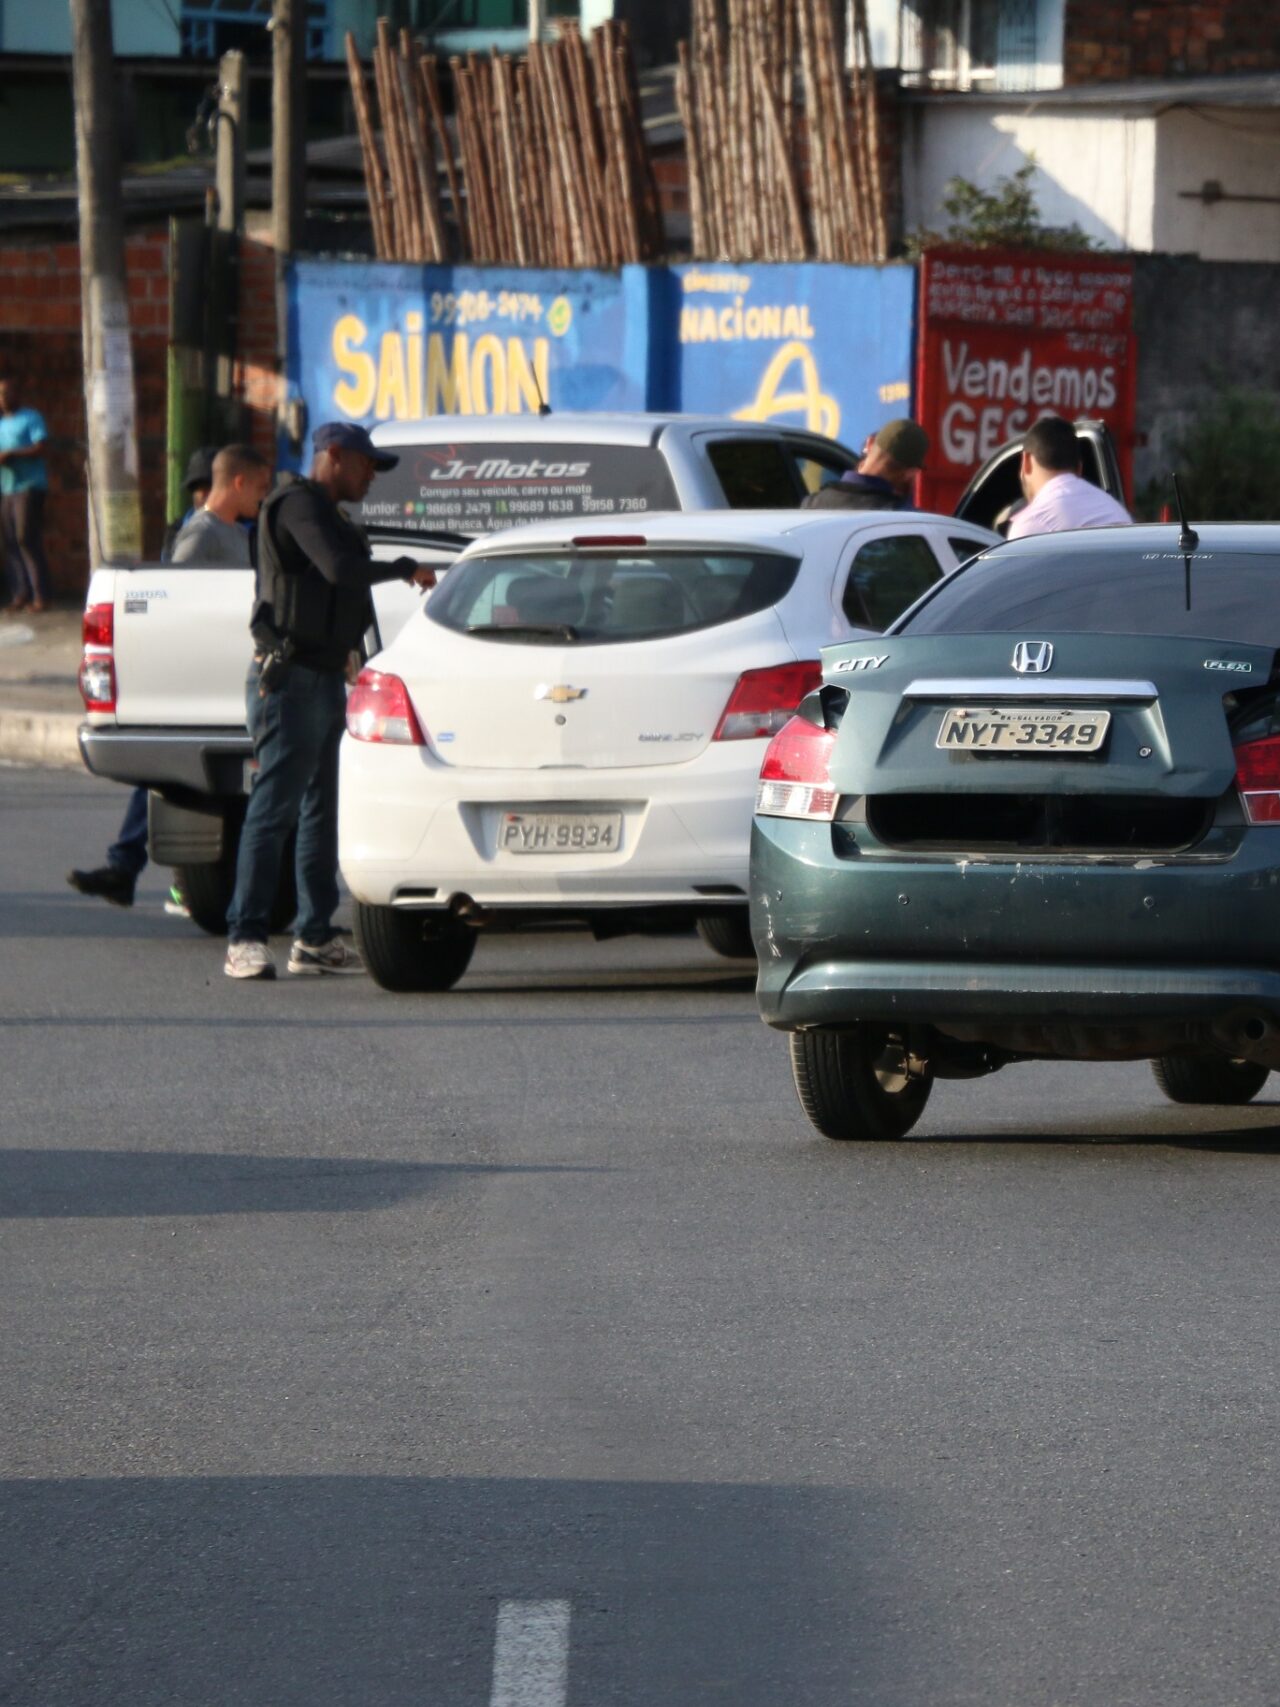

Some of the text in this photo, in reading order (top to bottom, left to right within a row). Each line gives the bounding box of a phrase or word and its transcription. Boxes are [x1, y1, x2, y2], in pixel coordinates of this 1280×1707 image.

[942, 338, 1117, 410] Vendemos
[942, 402, 1058, 465] GES
[420, 486, 461, 498] Compro
[462, 488, 479, 496] seu
[522, 486, 547, 495] carro
[550, 485, 564, 494] ou
[565, 484, 592, 493] moto
[832, 655, 890, 673] CITY
[1209, 661, 1247, 670] FLEX
[945, 722, 1098, 745] NYT-3349
